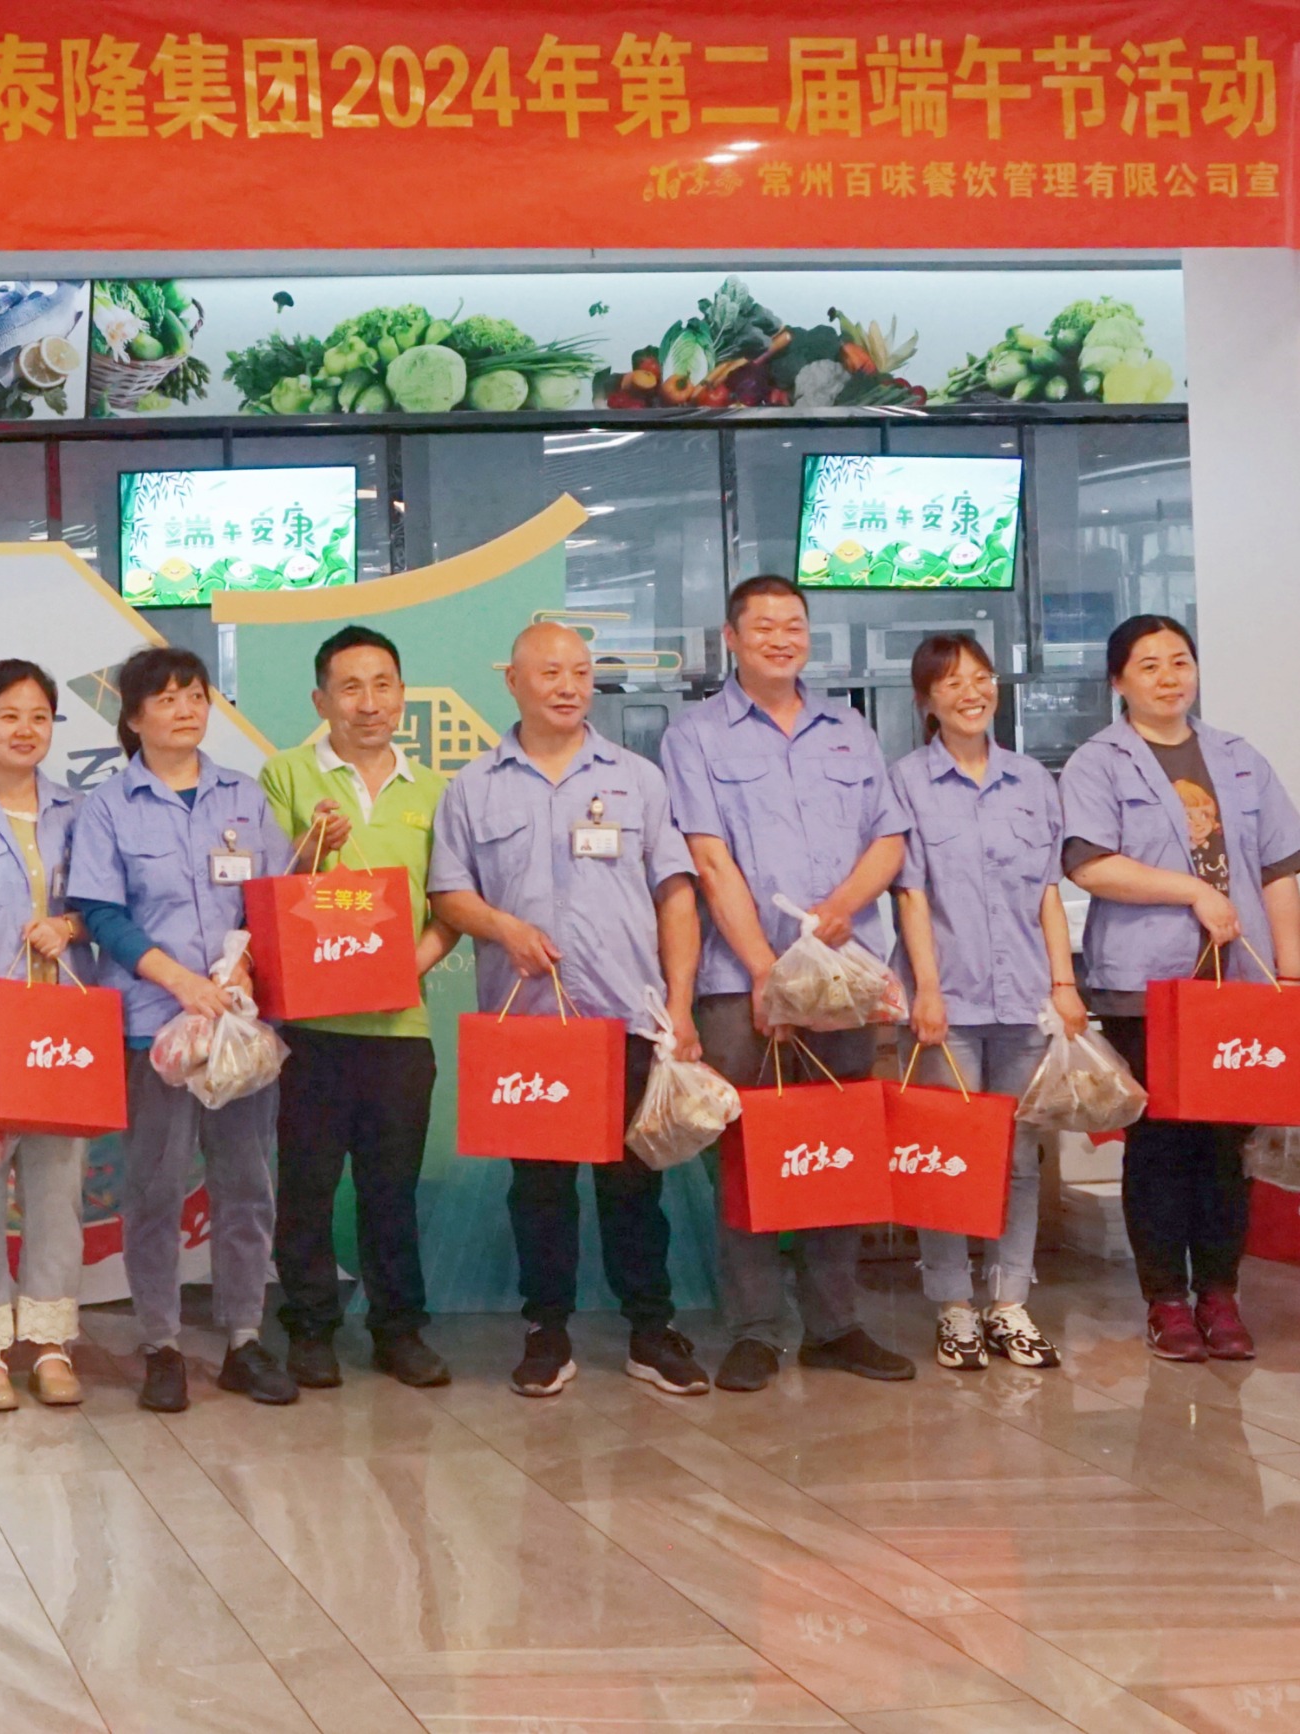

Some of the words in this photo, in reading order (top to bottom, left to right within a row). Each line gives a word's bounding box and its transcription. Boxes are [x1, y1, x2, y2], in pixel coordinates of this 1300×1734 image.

[757, 161, 1281, 199] 常州百味餐饮管理有限公司宣
[164, 501, 316, 548] 端午安康
[842, 490, 981, 536] 端午安康
[314, 888, 374, 911] 三等奖
